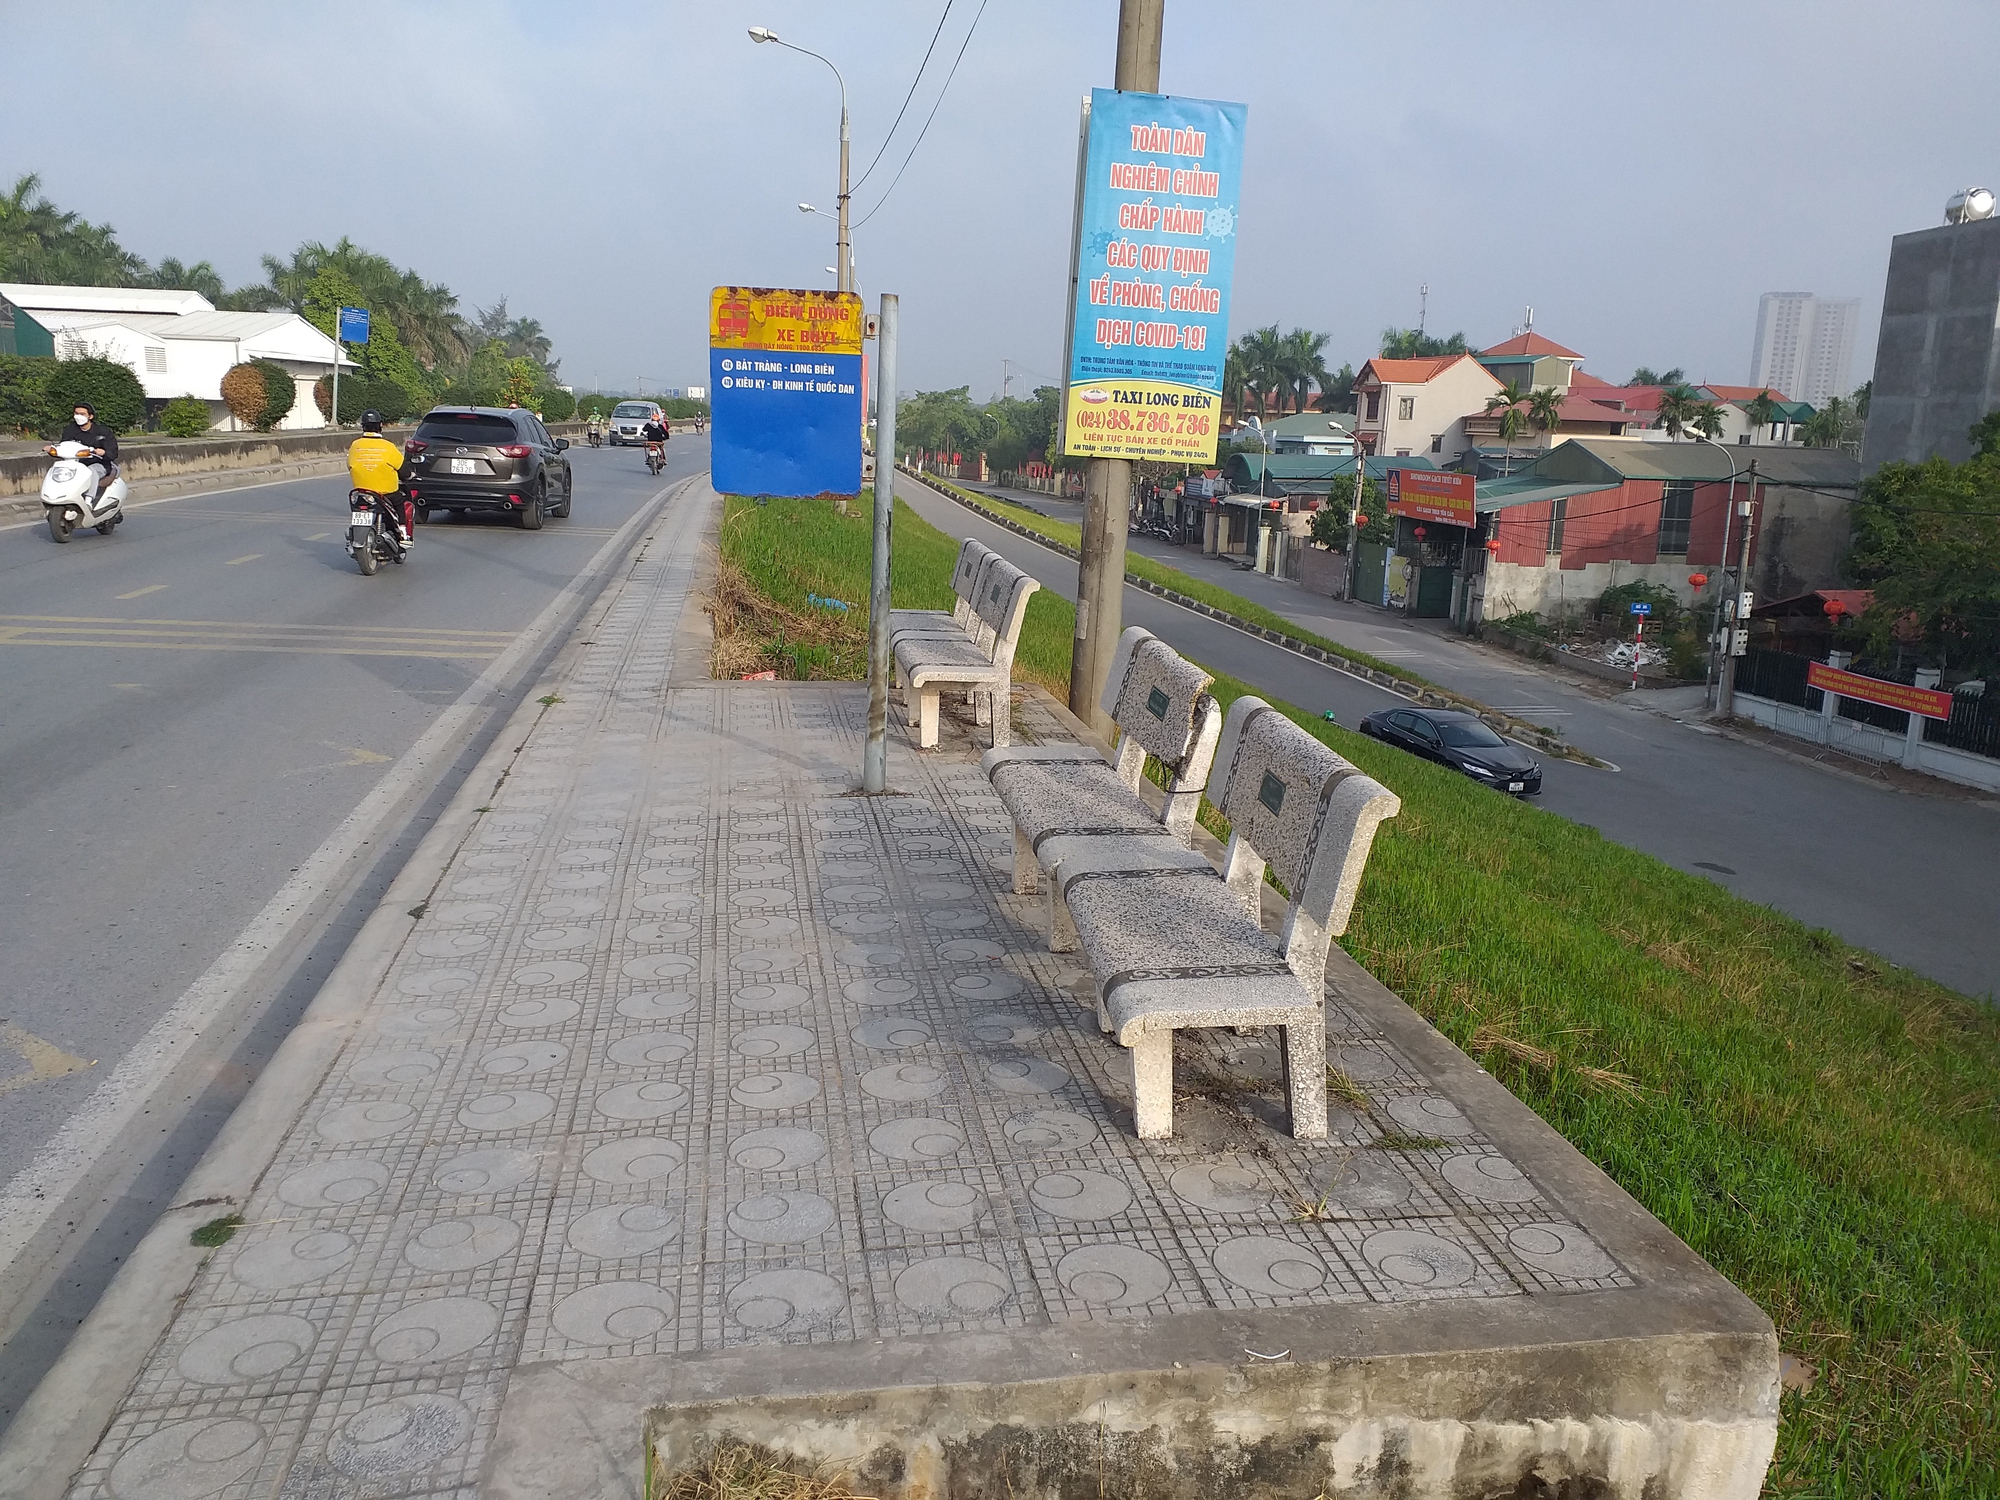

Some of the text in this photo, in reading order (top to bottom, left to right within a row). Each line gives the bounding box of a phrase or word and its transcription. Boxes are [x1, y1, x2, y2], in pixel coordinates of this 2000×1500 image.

[1131, 121, 1206, 157] TOÀN DÂN
[1110, 161, 1219, 197] NGHIÊM CHỈNH
[1120, 197, 1204, 235] CHẤP HÀNH
[1107, 238, 1210, 278] CÁC QUY ĐỊNH
[1090, 273, 1220, 314] VỀ PHÒNG, CHỐNG
[777, 328, 795, 342] XE
[1096, 319, 1206, 351] DỊCH COVID-19!
[754, 360, 782, 372] TRÀNG
[790, 363, 812, 374] LONG
[814, 362, 834, 375] BIÊN
[772, 380, 783, 390] ĐH
[784, 381, 804, 391] KINH
[805, 379, 814, 392] TẾ
[816, 380, 836, 393] QUỐC
[1112, 390, 1143, 404] TAXI
[1146, 392, 1179, 406] LONG
[1182, 392, 1212, 409] BIÊN
[1082, 444, 1096, 452] TOÀN
[1147, 448, 1166, 456] NGHIỆP
[1084, 432, 1104, 442] LIÊN
[1107, 434, 1123, 444] TỤC
[1126, 434, 1144, 444] BÁN
